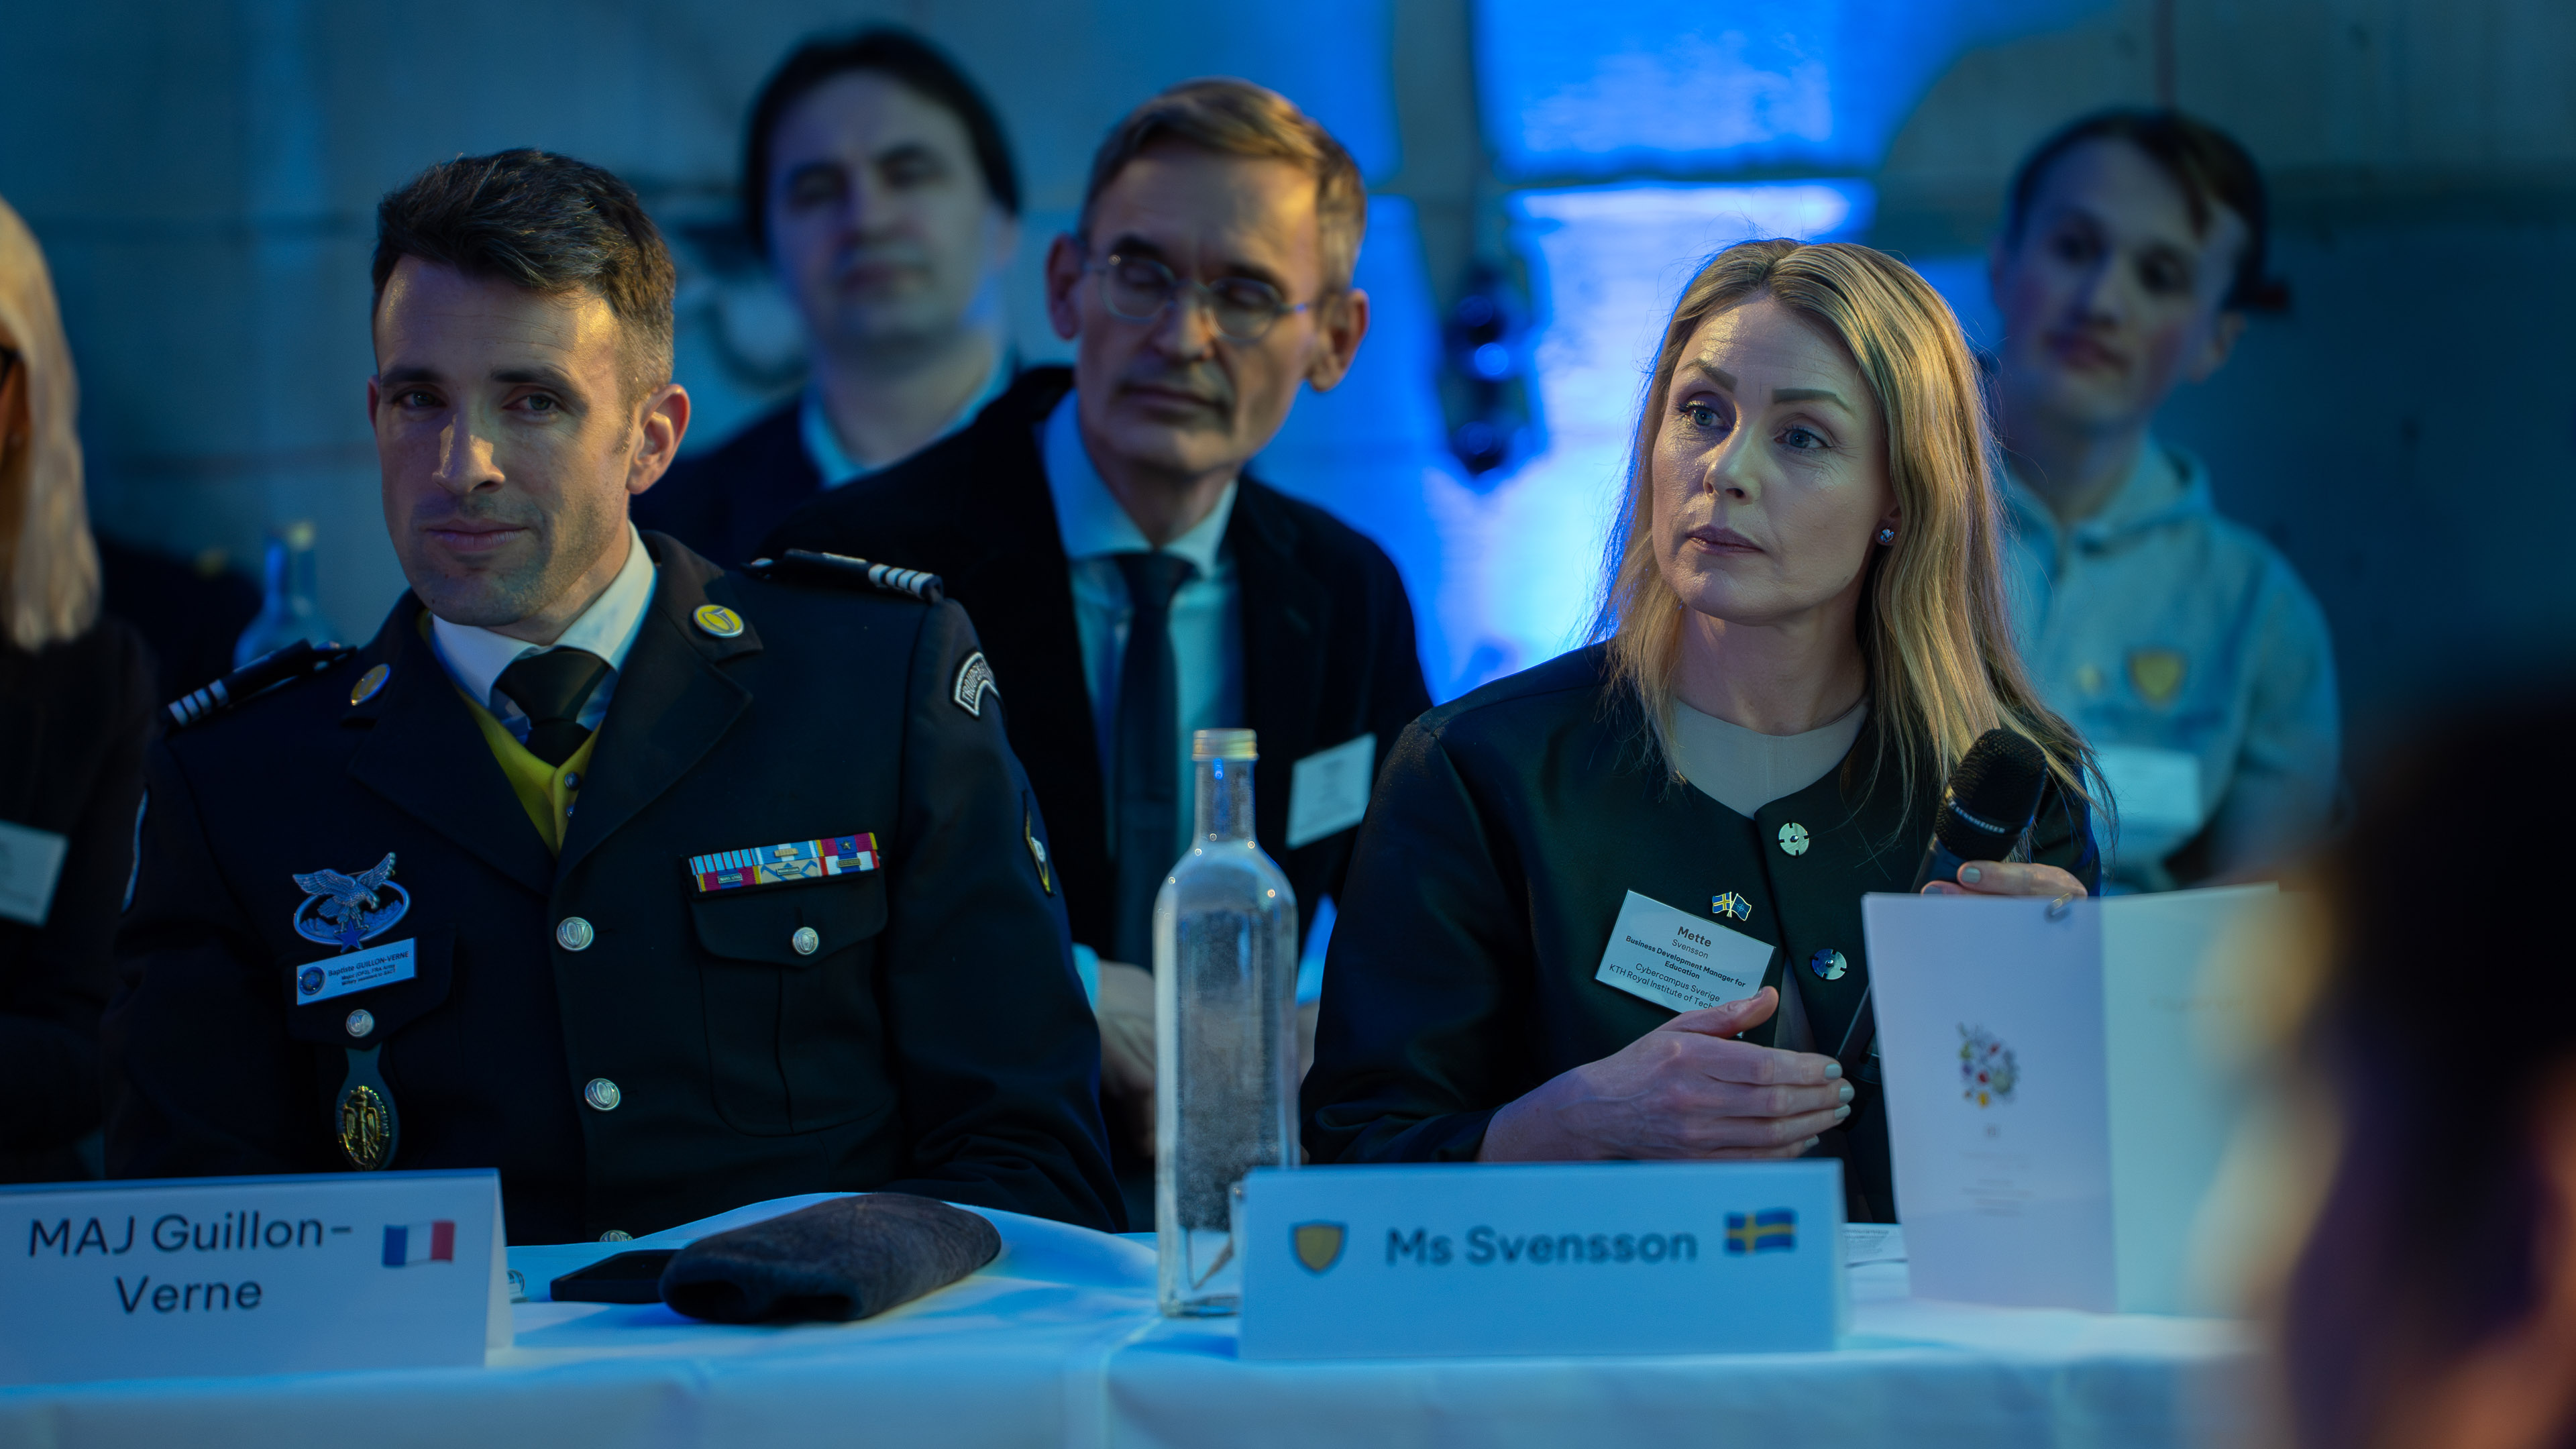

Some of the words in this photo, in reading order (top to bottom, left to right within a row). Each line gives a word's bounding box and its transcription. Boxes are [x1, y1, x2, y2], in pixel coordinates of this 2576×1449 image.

[1672, 938, 1709, 959] Svensson
[1677, 926, 1711, 947] Mette
[328, 966, 355, 977] Baptiste
[356, 951, 409, 969] GUILLON-VERNE
[1625, 935, 1656, 952] Business
[1656, 947, 1703, 971] Development
[1703, 965, 1734, 983] Manager
[1734, 978, 1746, 987] for
[1664, 960, 1700, 979] Education
[1609, 963, 1627, 976] KTH
[1626, 970, 1650, 985] Royal
[1650, 979, 1682, 998] Institute
[1635, 963, 1690, 989] Cybercampus
[1690, 985, 1720, 1002] Sverige
[28, 1216, 136, 1257] MAJ
[151, 1211, 352, 1253] Guillon-
[1385, 1228, 1452, 1265] Ms
[1465, 1226, 1699, 1266] Svensson
[115, 1276, 262, 1314] Verne
